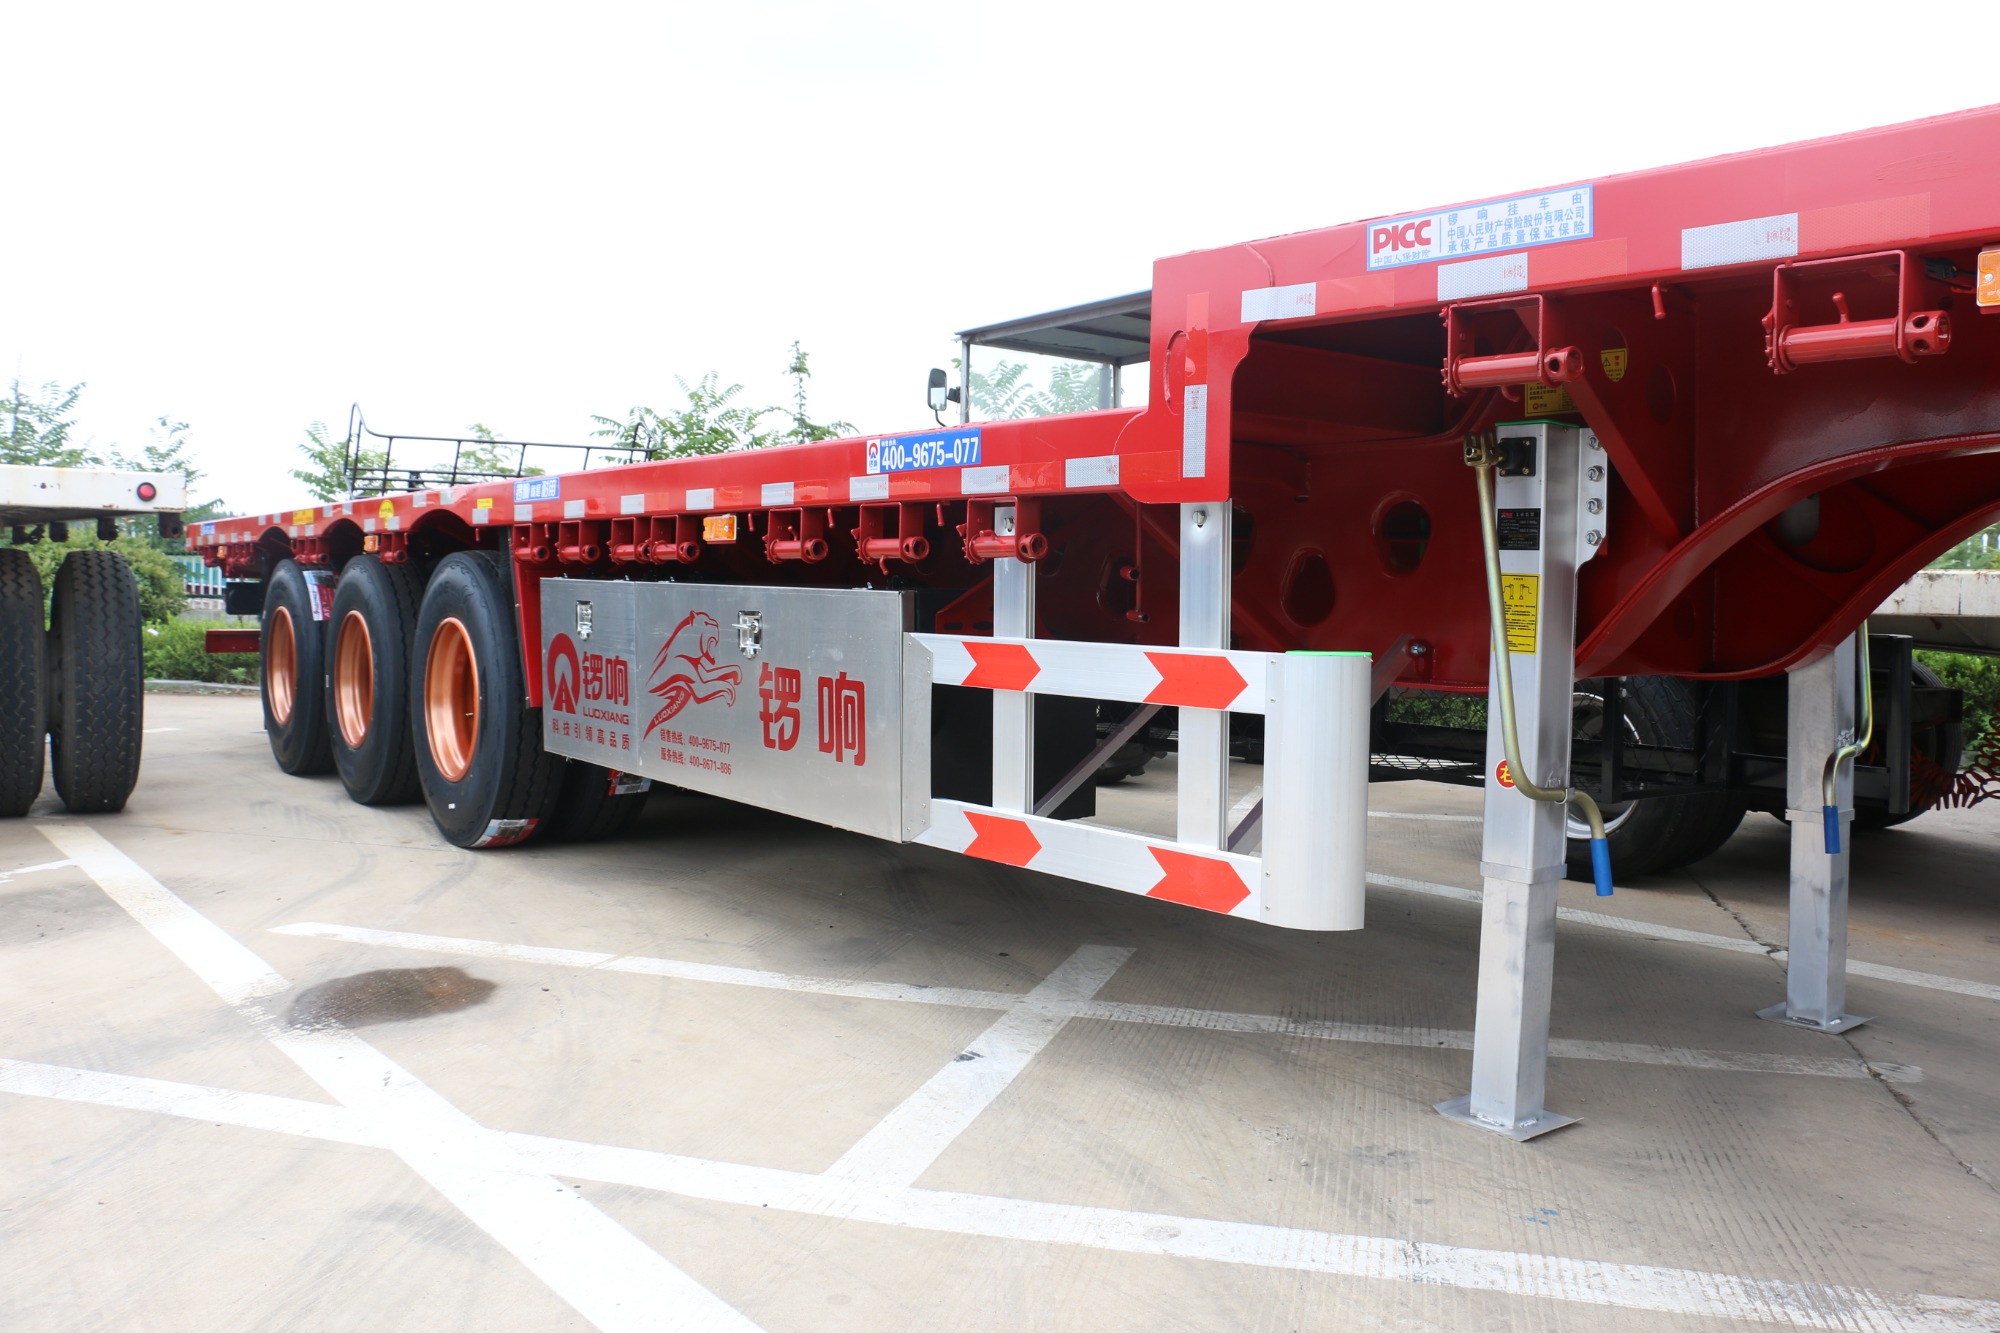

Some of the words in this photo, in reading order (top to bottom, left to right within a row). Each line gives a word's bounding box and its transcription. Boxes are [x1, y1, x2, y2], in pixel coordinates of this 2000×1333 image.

[1373, 219, 1432, 254] PICC
[1447, 205, 1585, 240] 中国人民财产保险股份有限公司
[1447, 220, 1585, 254] 承保产品质量保证保险
[881, 436, 979, 470] 400-9675-077
[582, 651, 629, 706] 锣响
[582, 706, 630, 725] LUOXIANG
[653, 690, 685, 725] LUOXIANG
[758, 661, 866, 767] 锣响
[552, 718, 630, 751] 科技引领高品质
